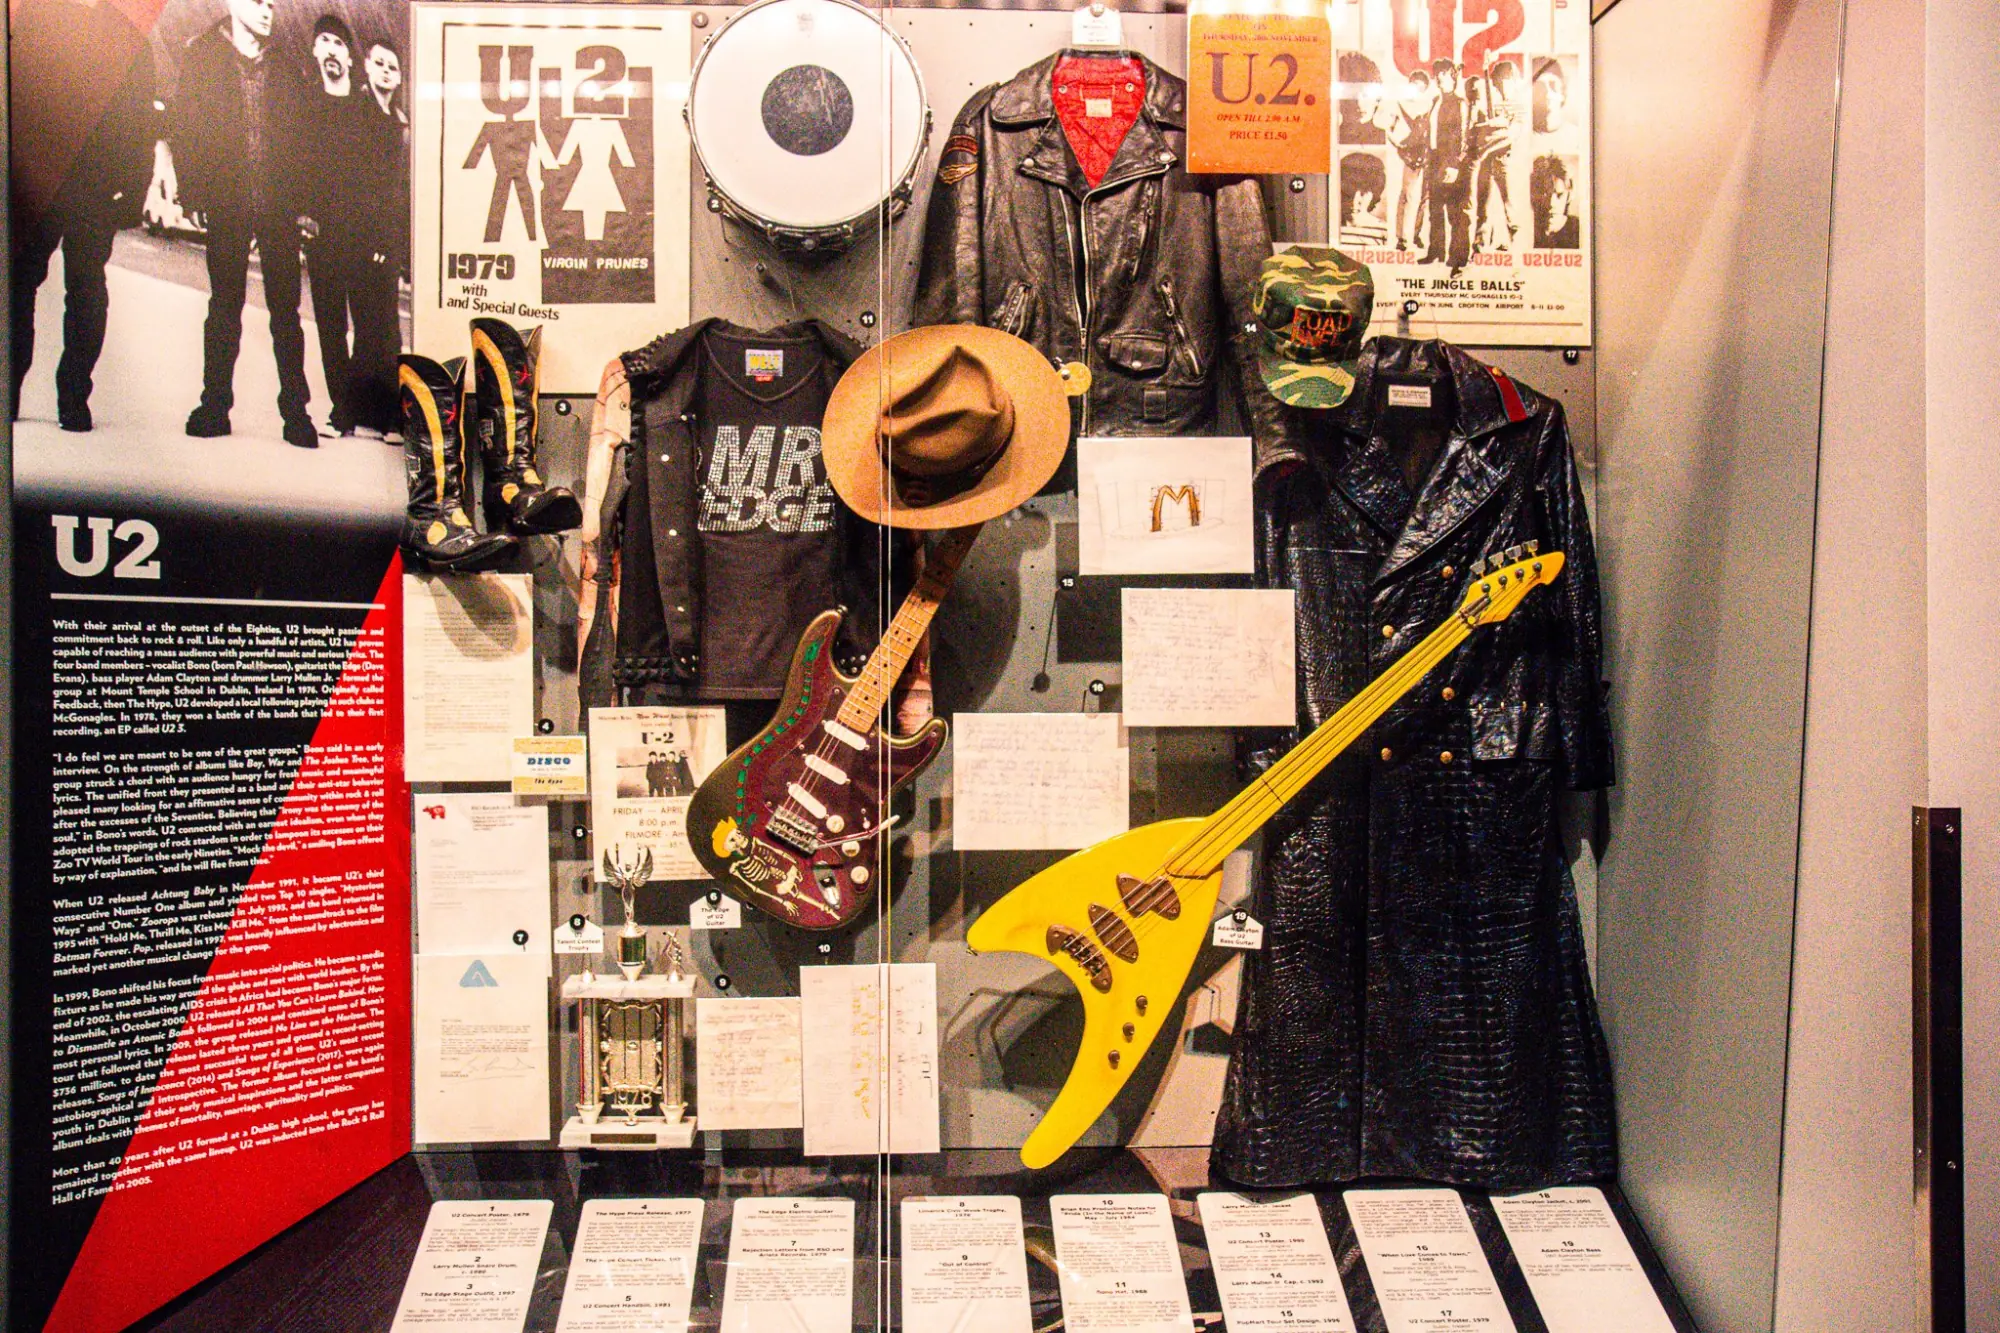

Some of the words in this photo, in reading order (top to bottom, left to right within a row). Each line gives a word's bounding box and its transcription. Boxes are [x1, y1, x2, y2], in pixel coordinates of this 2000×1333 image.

[1205, 52, 1316, 106] U.2.
[1217, 114, 1240, 122] OPEN
[1244, 114, 1262, 122] TILL
[1229, 130, 1261, 140] PRICE
[1292, 180, 1304, 189] 13
[448, 253, 515, 280] 1979
[543, 257, 588, 269] VIRGIN
[596, 258, 648, 270] PRUNES
[1431, 280, 1474, 291] JINGLE
[462, 284, 488, 297] with
[447, 296, 469, 310] and
[472, 298, 516, 316] Special
[518, 304, 560, 321] Guests
[1405, 302, 1417, 312] 18
[862, 315, 874, 324] 11
[1244, 323, 1257, 332] 14
[1566, 349, 1576, 358] 17
[559, 403, 567, 412] 3
[697, 485, 836, 533] EDGE
[51, 515, 161, 579] U2
[1062, 577, 1074, 586] 15
[52, 619, 78, 629] With
[84, 620, 107, 630] their
[112, 620, 141, 630] arrival
[146, 623, 156, 631] at
[161, 621, 176, 631] the
[181, 624, 209, 632] outset
[213, 622, 223, 632] of
[227, 623, 241, 633] the
[286, 624, 299, 634] U2
[303, 624, 334, 637] brought
[338, 626, 366, 637] passion
[370, 626, 383, 635] and
[1092, 682, 1104, 692] 16
[52, 725, 102, 738] recording,
[117, 724, 132, 734] EP
[132, 723, 160, 734] called
[161, 723, 176, 733] U2
[542, 722, 550, 731] 4
[613, 807, 643, 815] FRIDAY
[576, 828, 583, 837] 5
[53, 872, 66, 885] by
[67, 873, 86, 884] way
[87, 869, 99, 879] of
[180, 861, 192, 872] he
[193, 860, 208, 870] will
[210, 858, 227, 869] flee
[228, 856, 248, 867] from
[710, 892, 717, 901] 6
[1234, 911, 1247, 920] 19
[574, 917, 581, 926] 8
[517, 933, 523, 942] 7
[818, 944, 831, 953] 10
[719, 978, 727, 987] 9
[52, 1191, 73, 1205] Hall
[74, 1188, 86, 1200] of
[87, 1182, 113, 1197] Fame
[115, 1180, 125, 1190] in
